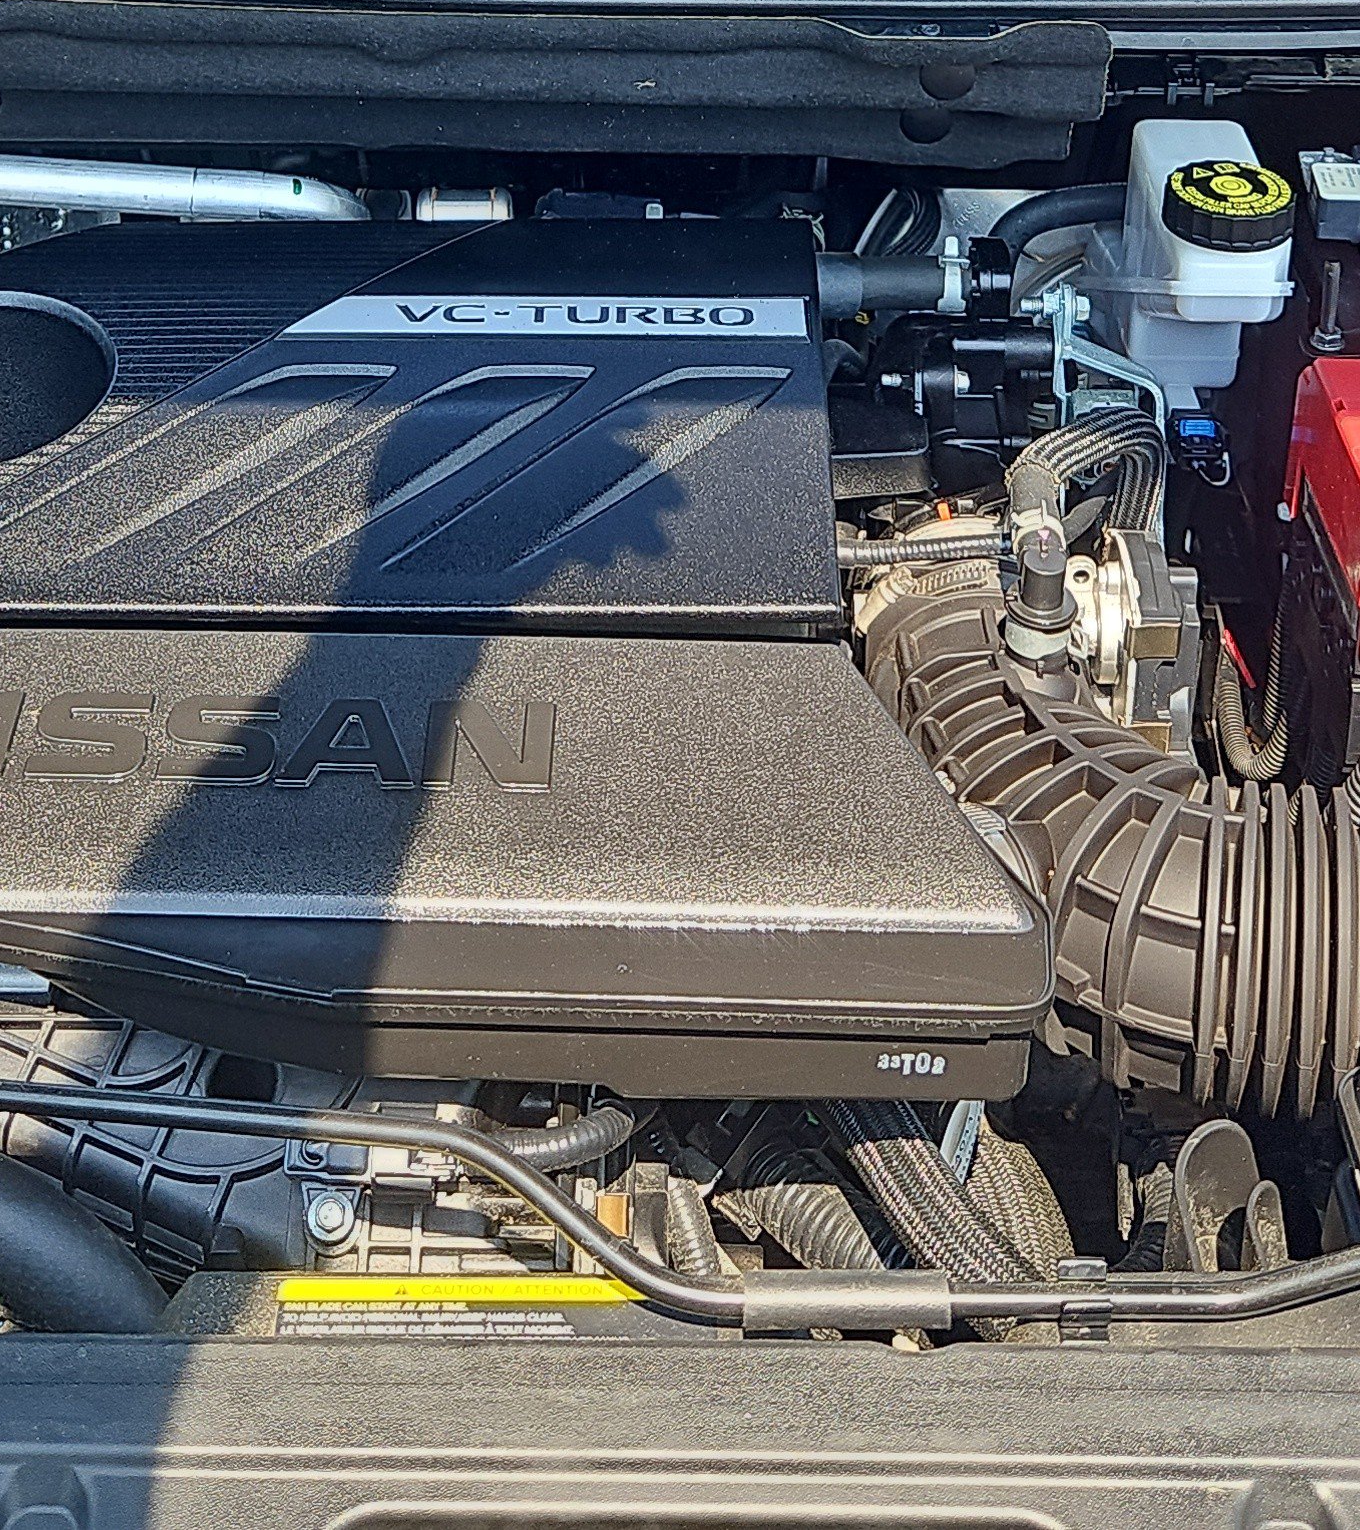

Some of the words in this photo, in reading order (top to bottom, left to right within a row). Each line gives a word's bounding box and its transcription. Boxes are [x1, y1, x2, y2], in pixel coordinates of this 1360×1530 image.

[395, 302, 755, 326] VC-TURBO
[421, 1284, 494, 1296] CAUTION
[513, 1284, 604, 1296] ATTENTION
